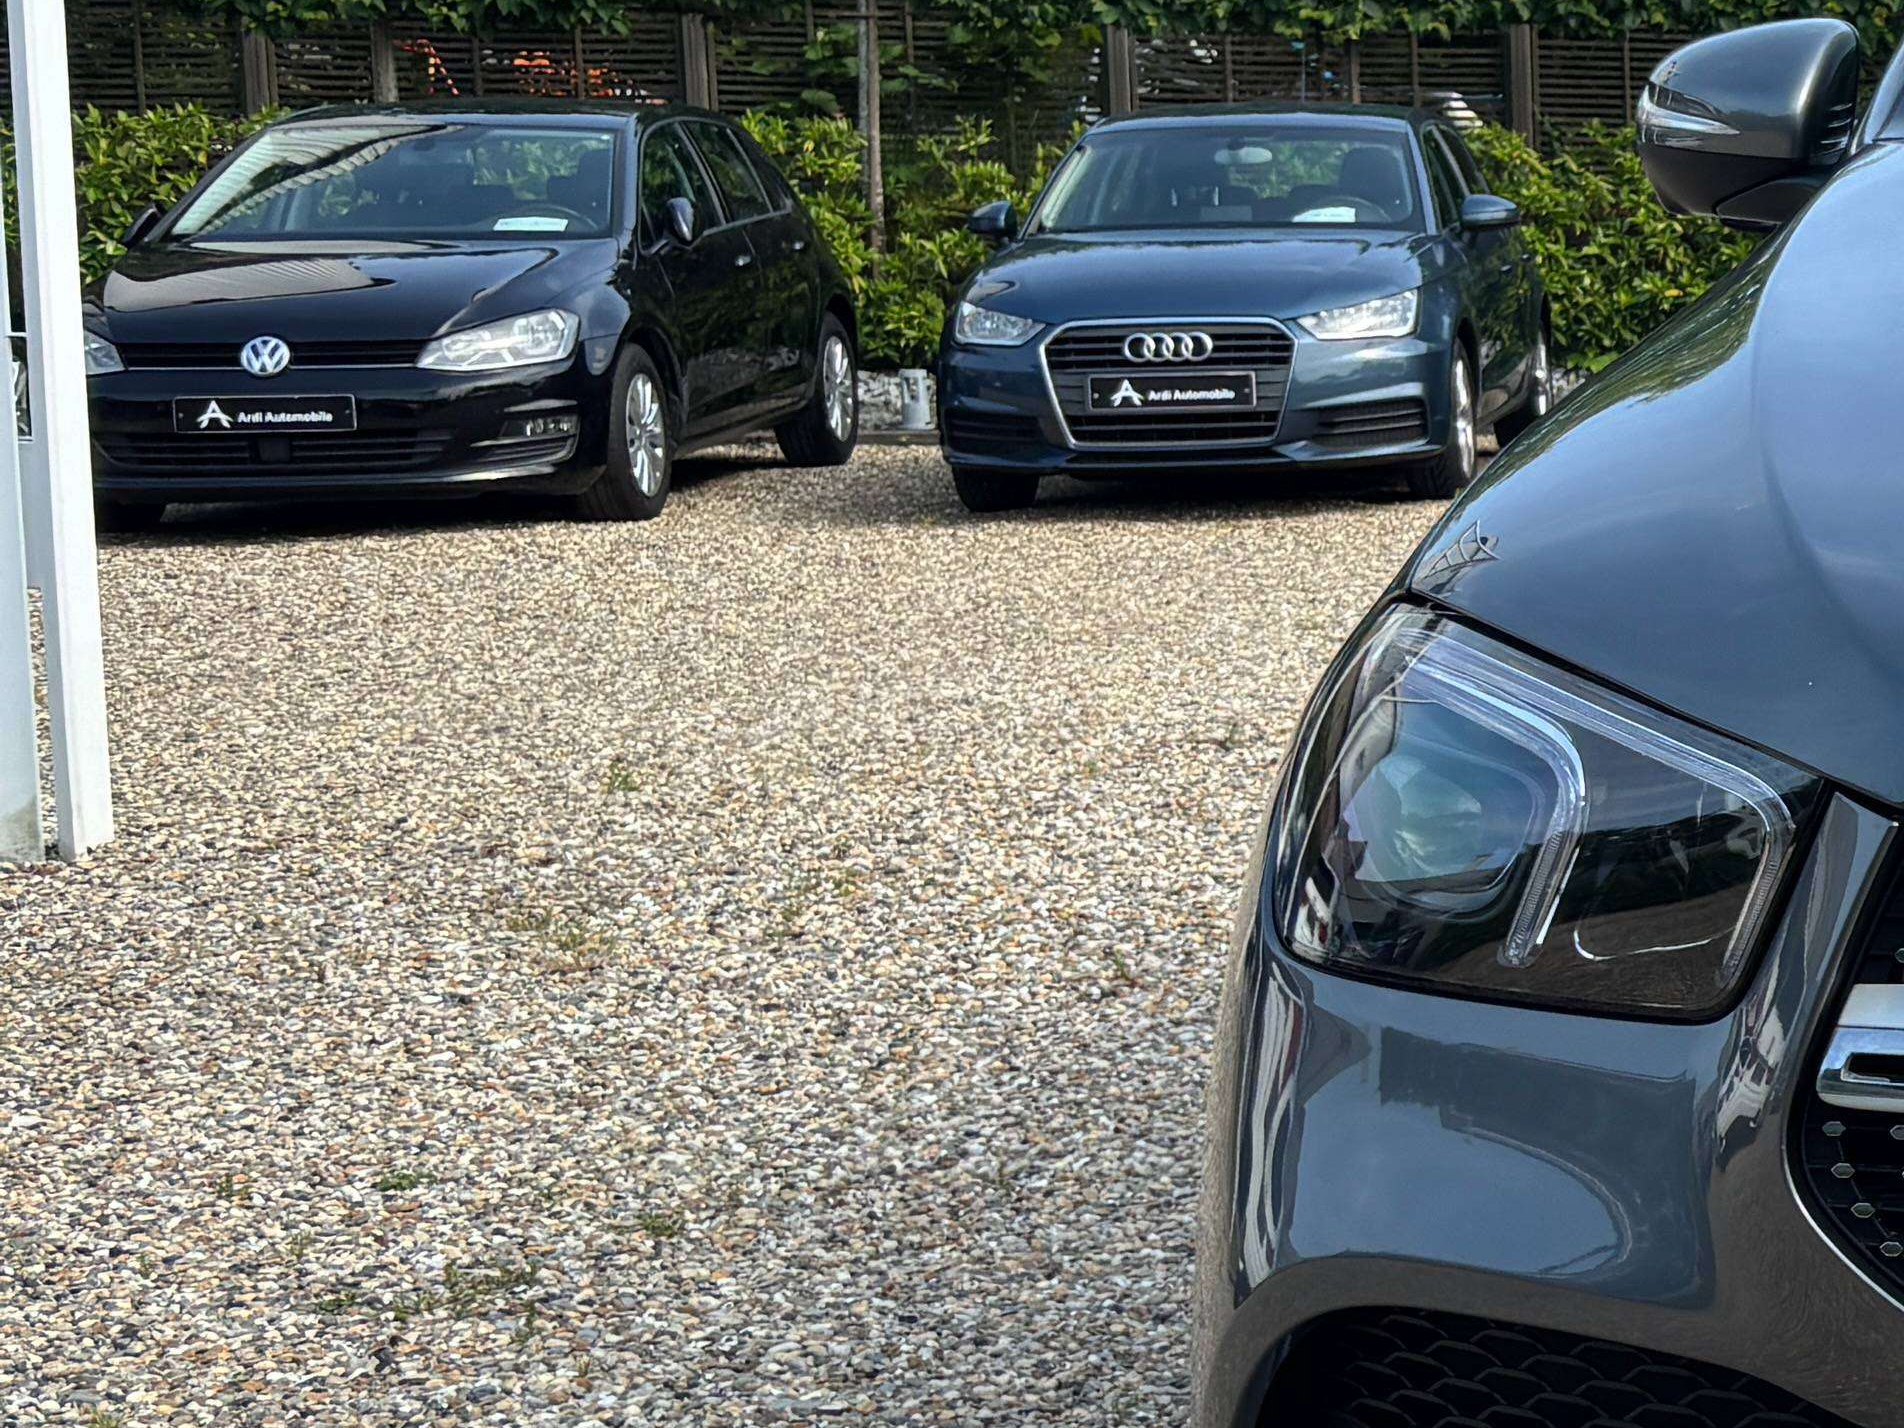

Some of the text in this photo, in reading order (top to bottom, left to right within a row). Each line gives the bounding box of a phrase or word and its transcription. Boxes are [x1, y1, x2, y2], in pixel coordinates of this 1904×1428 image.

[1147, 387, 1236, 401] Ardi Automobile
[237, 410, 333, 423] Ardi Automobile
